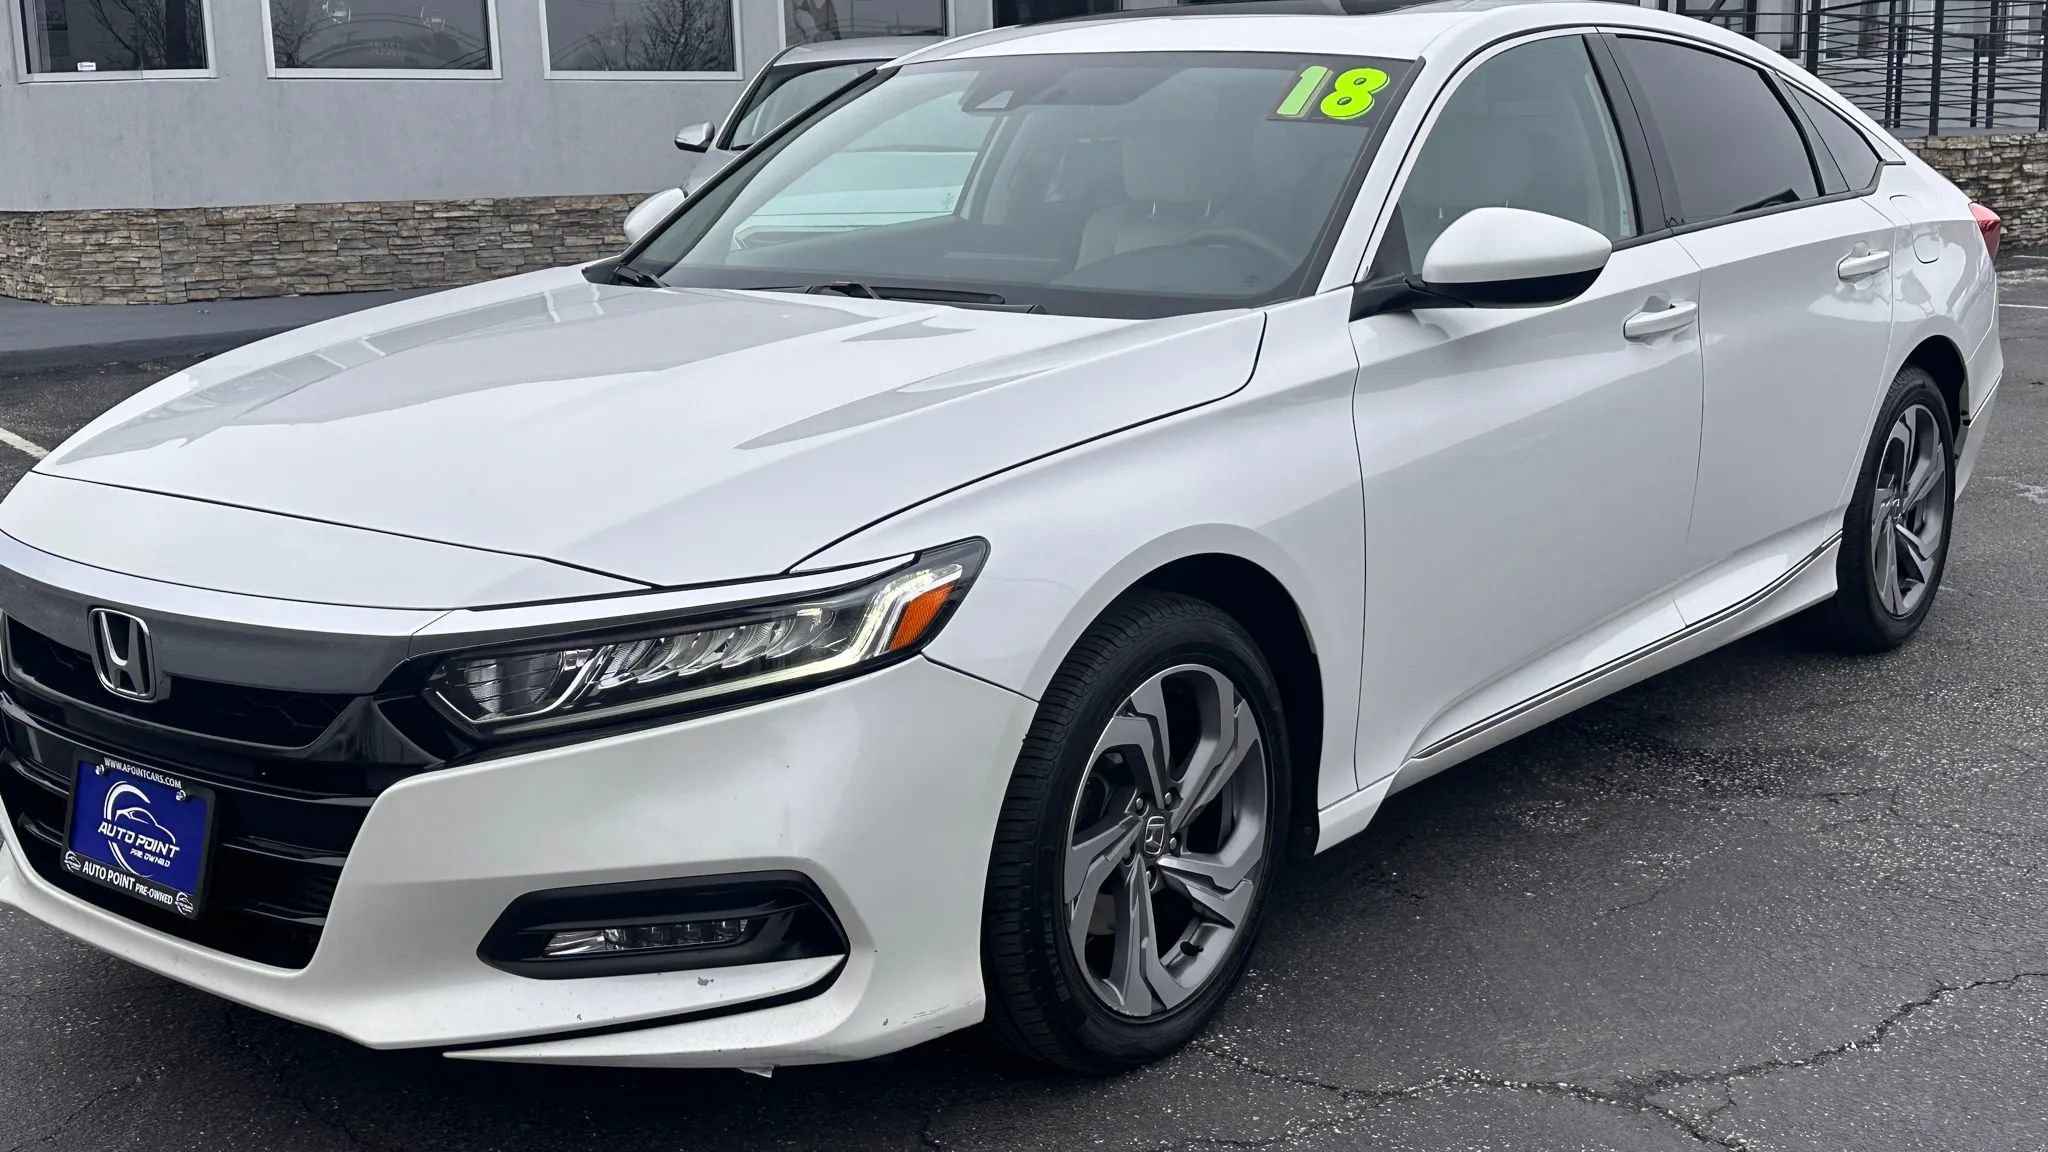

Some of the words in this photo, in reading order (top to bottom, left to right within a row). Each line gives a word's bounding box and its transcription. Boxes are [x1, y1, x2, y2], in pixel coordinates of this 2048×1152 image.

[1276, 65, 1390, 120] 18
[104, 757, 182, 789] WWW.APOINTCARS.COM
[98, 821, 135, 844] AUTO
[136, 834, 180, 858] POINT
[82, 861, 106, 880] AUTO
[107, 869, 135, 891] POINT
[135, 883, 173, 905] PRE-OWNED
